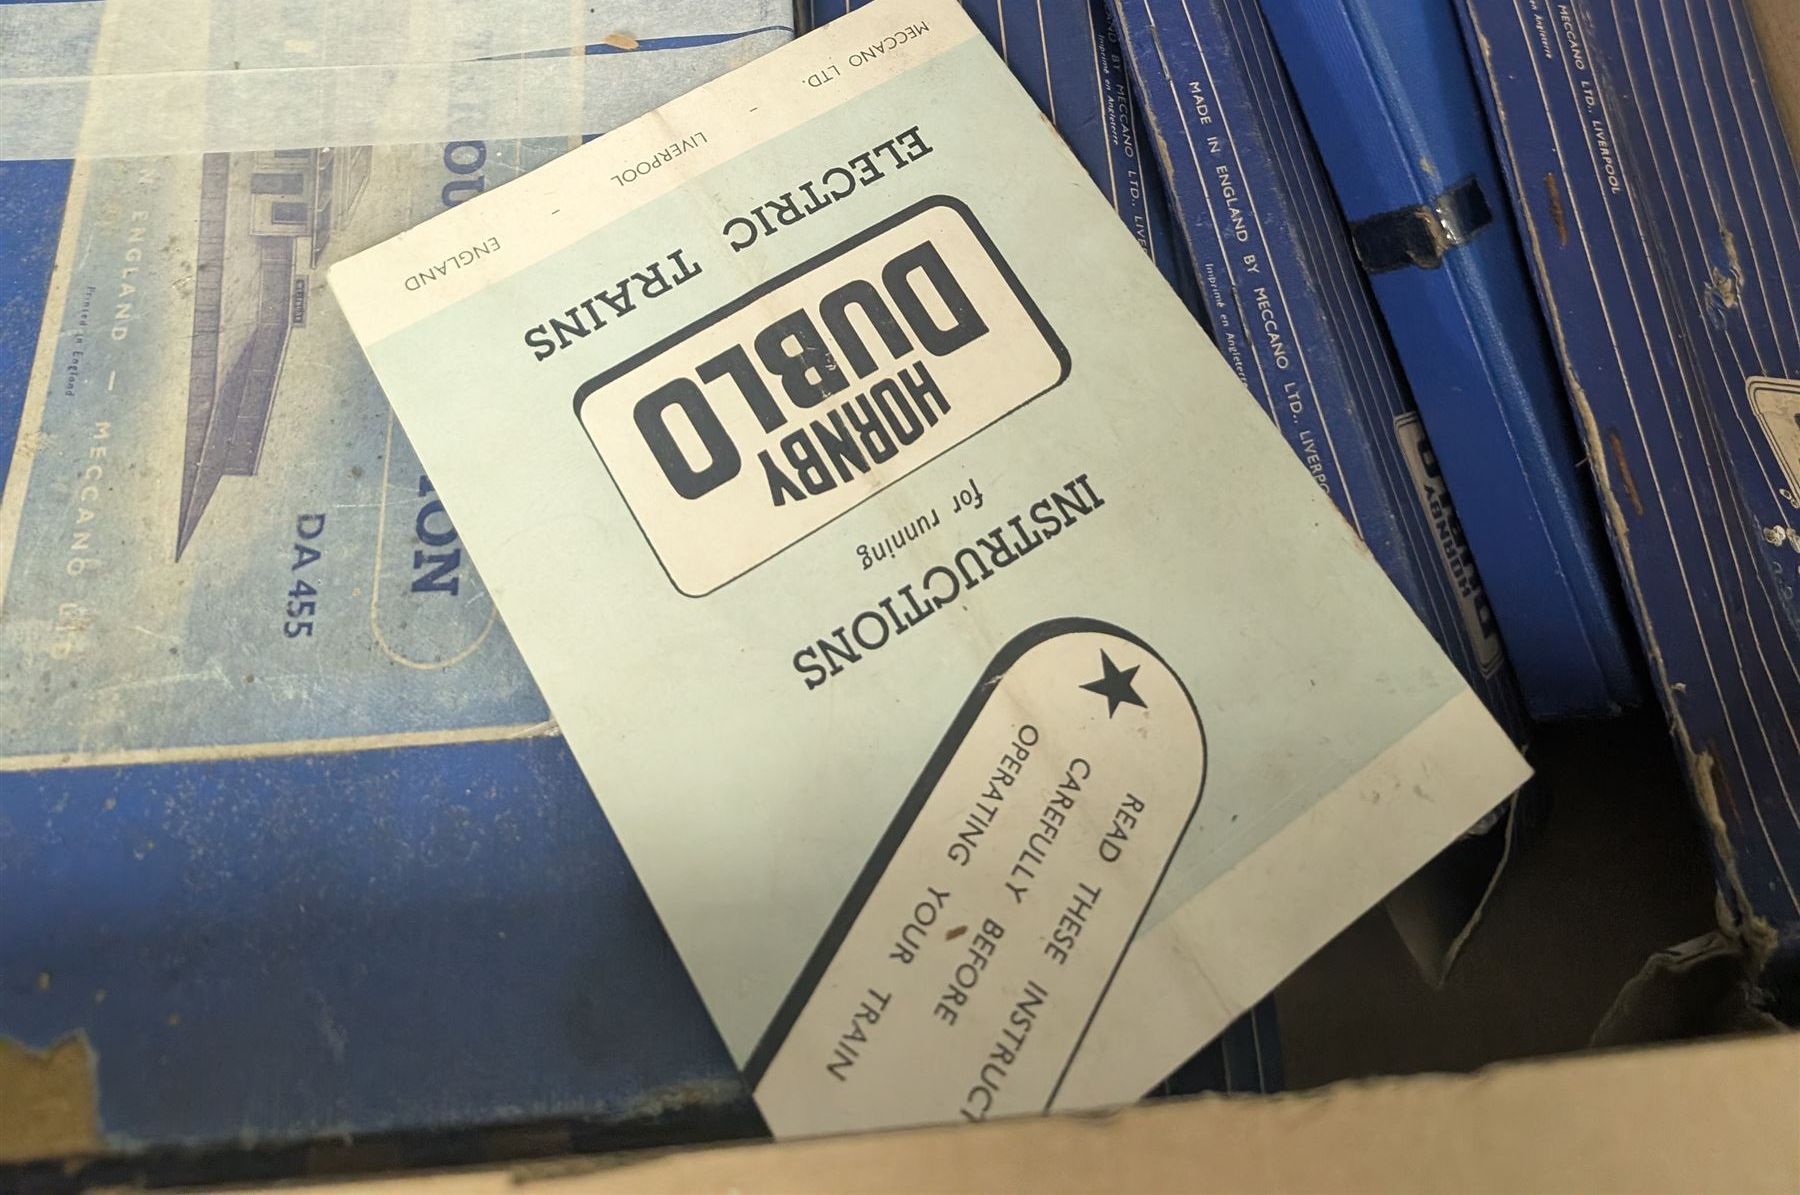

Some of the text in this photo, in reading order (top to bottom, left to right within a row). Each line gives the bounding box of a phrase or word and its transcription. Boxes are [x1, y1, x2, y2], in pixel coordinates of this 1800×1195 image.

[802, 65, 840, 87] LTD.
[849, 21, 929, 66] MECCANO
[1558, 4, 1585, 72] MECCANO
[1592, 120, 1621, 194] LIVERPOOL
[611, 132, 707, 186] LIVERPOOL
[1115, 84, 1135, 158] MECCANO
[111, 210, 149, 341] ENGLAND
[405, 238, 500, 290] ENGLAND
[525, 126, 933, 361] ELECTRIC TRAINS
[1189, 81, 1212, 125] MADE
[1206, 136, 1221, 154] IN
[1216, 165, 1248, 243] ENGLAND
[1243, 254, 1260, 274] BY
[1253, 287, 1289, 370] MECCANO
[65, 351, 84, 397] England
[634, 241, 989, 499] DUBLO
[1219, 313, 1228, 328] en
[758, 361, 951, 506] HORNBY
[67, 420, 111, 577] MECCANO
[857, 479, 982, 570] for running
[1423, 484, 1472, 598] HORNBY
[283, 513, 326, 639] DA 455
[794, 474, 1104, 689] INSTRUCTIONS
[1100, 794, 1144, 862] READ
[827, 725, 1038, 1081] OPERATING YOUR TRAIN
[935, 759, 1090, 1025] CAREFULLY BEFORE
[1045, 886, 1101, 964] THESE
